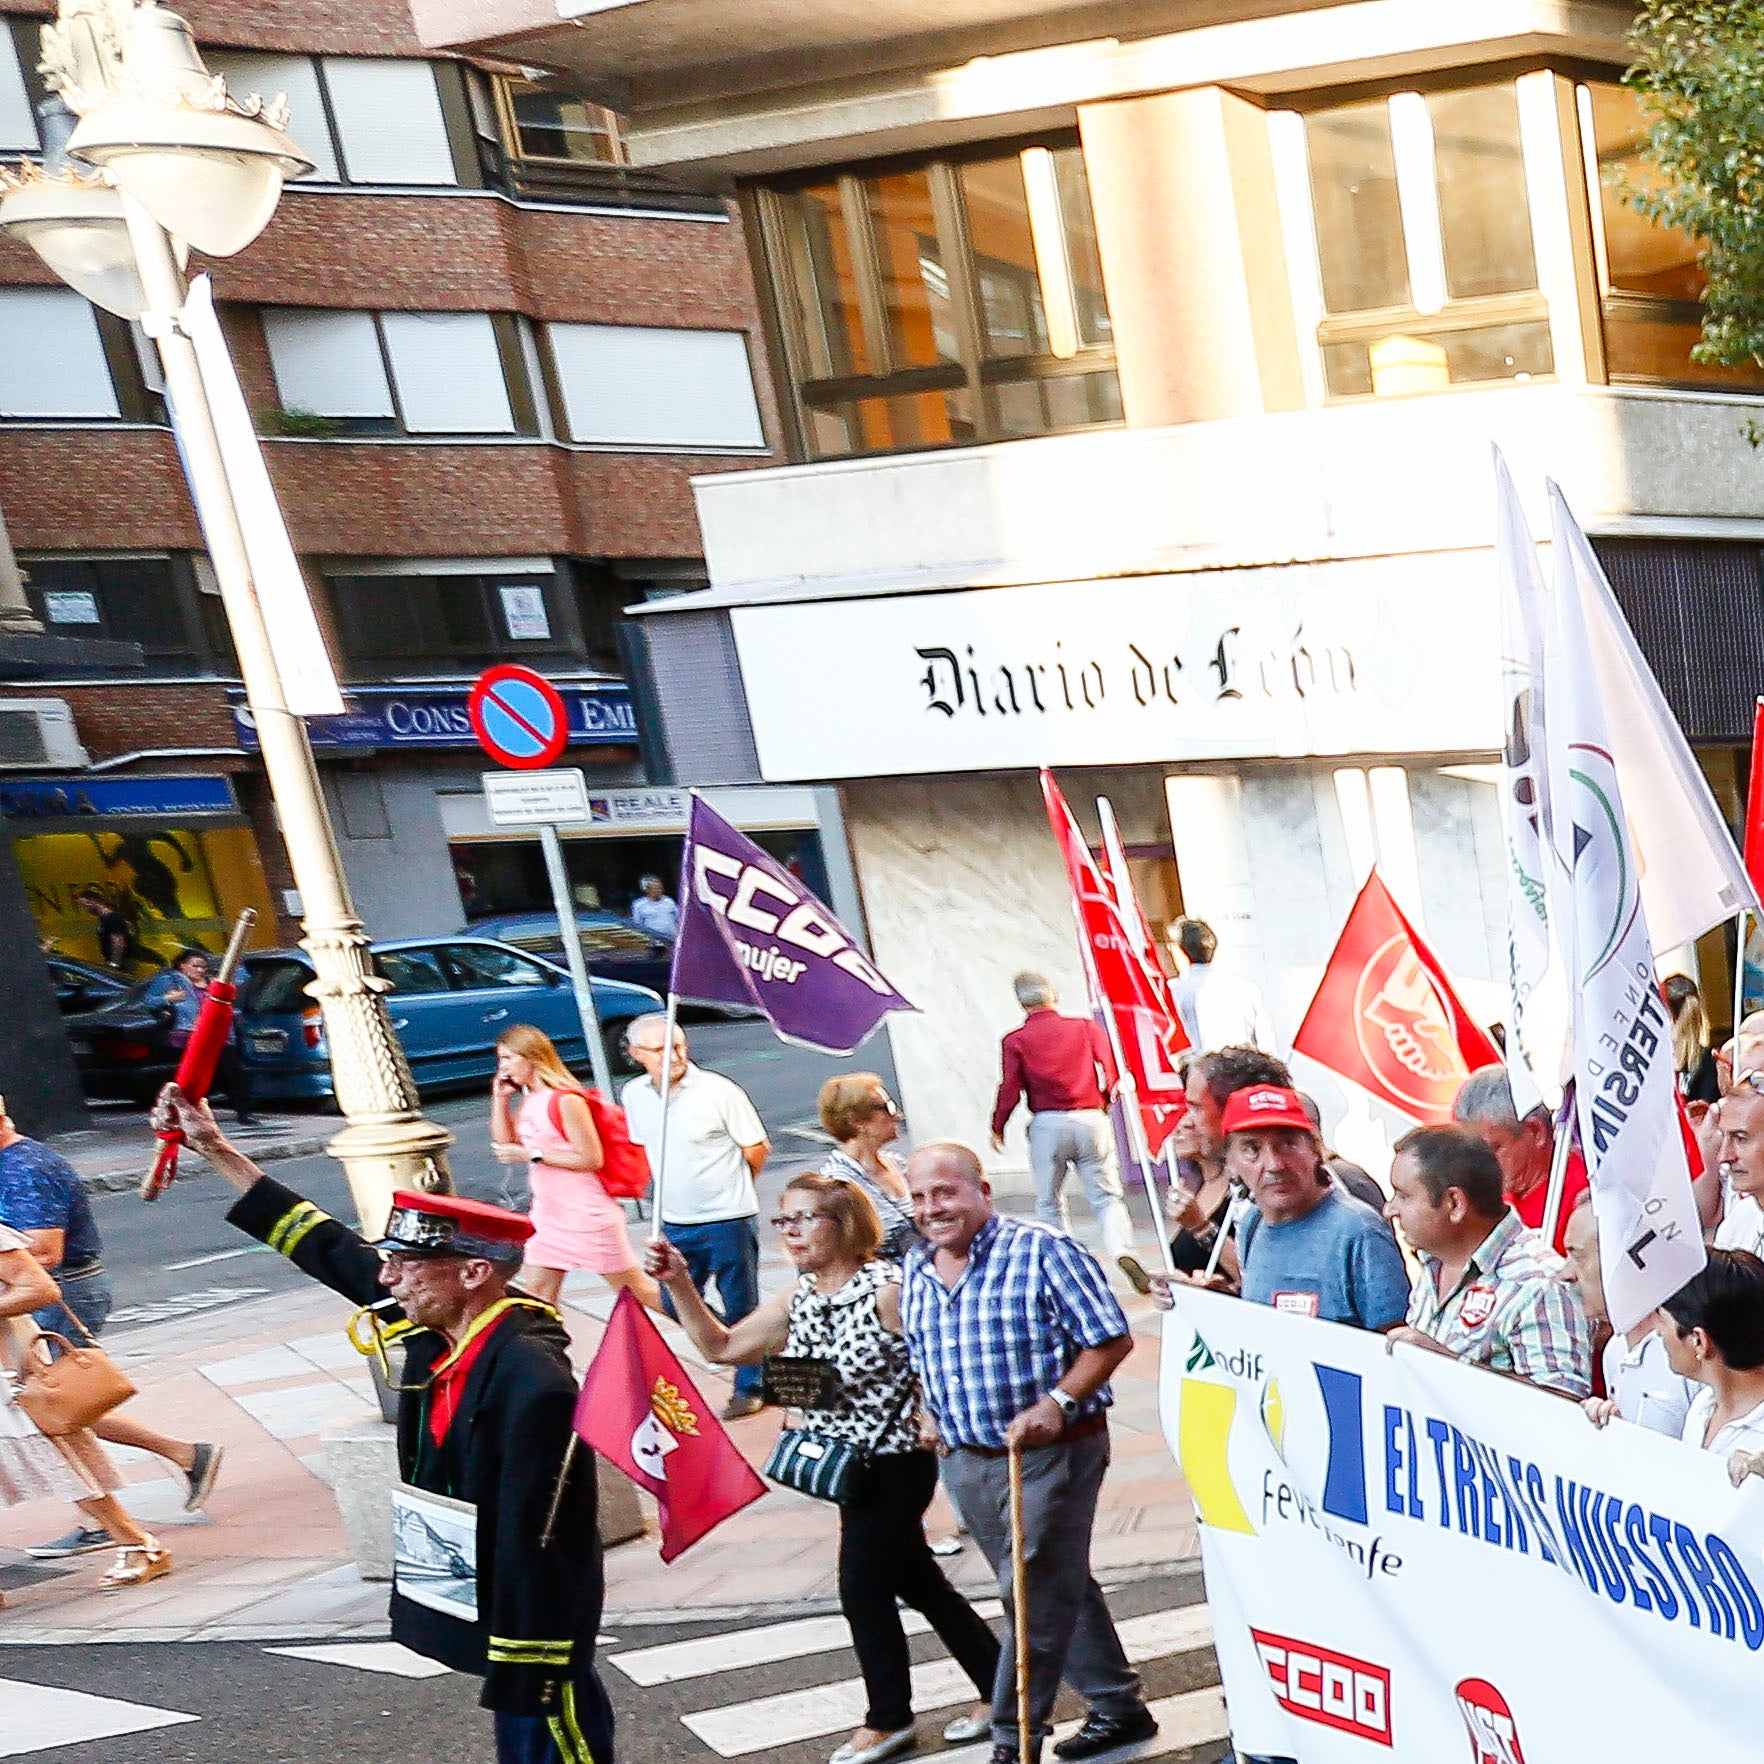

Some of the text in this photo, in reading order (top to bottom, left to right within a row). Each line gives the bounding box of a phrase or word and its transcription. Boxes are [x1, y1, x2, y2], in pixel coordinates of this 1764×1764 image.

[913, 623, 1358, 718] Diario de León
[1383, 1404, 1425, 1522] EL
[1425, 1416, 1529, 1555] TREN
